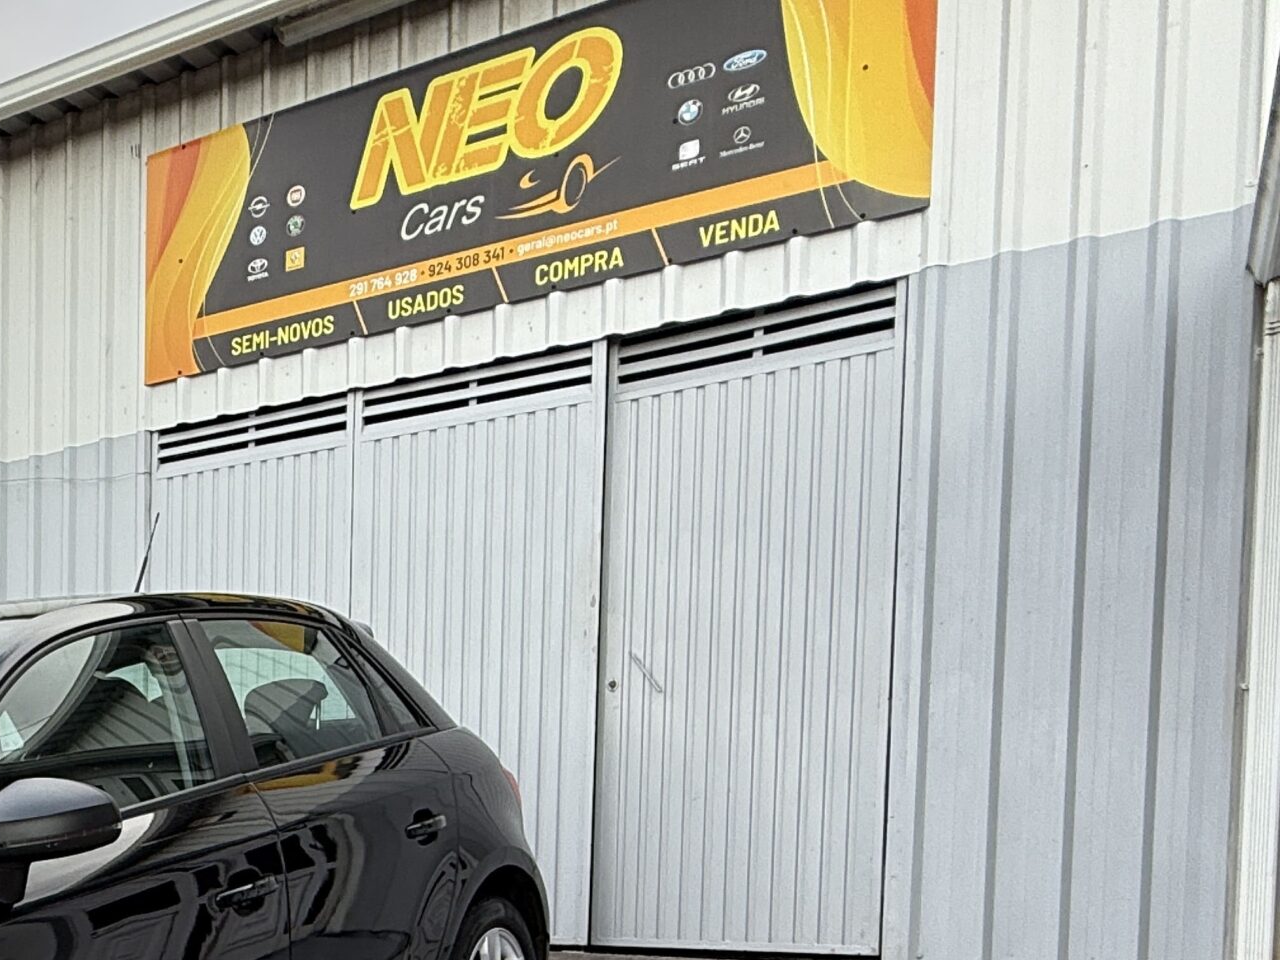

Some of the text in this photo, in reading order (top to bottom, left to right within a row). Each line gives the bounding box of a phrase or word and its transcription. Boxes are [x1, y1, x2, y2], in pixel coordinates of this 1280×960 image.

[350, 26, 623, 210] NEO
[349, 218, 619, 298] 291 764 928 924 308 341 geral@neocars.pt
[400, 195, 485, 241] Cars
[231, 209, 780, 356] SEMI-NOVOS USADOS COMPRA VENDA
